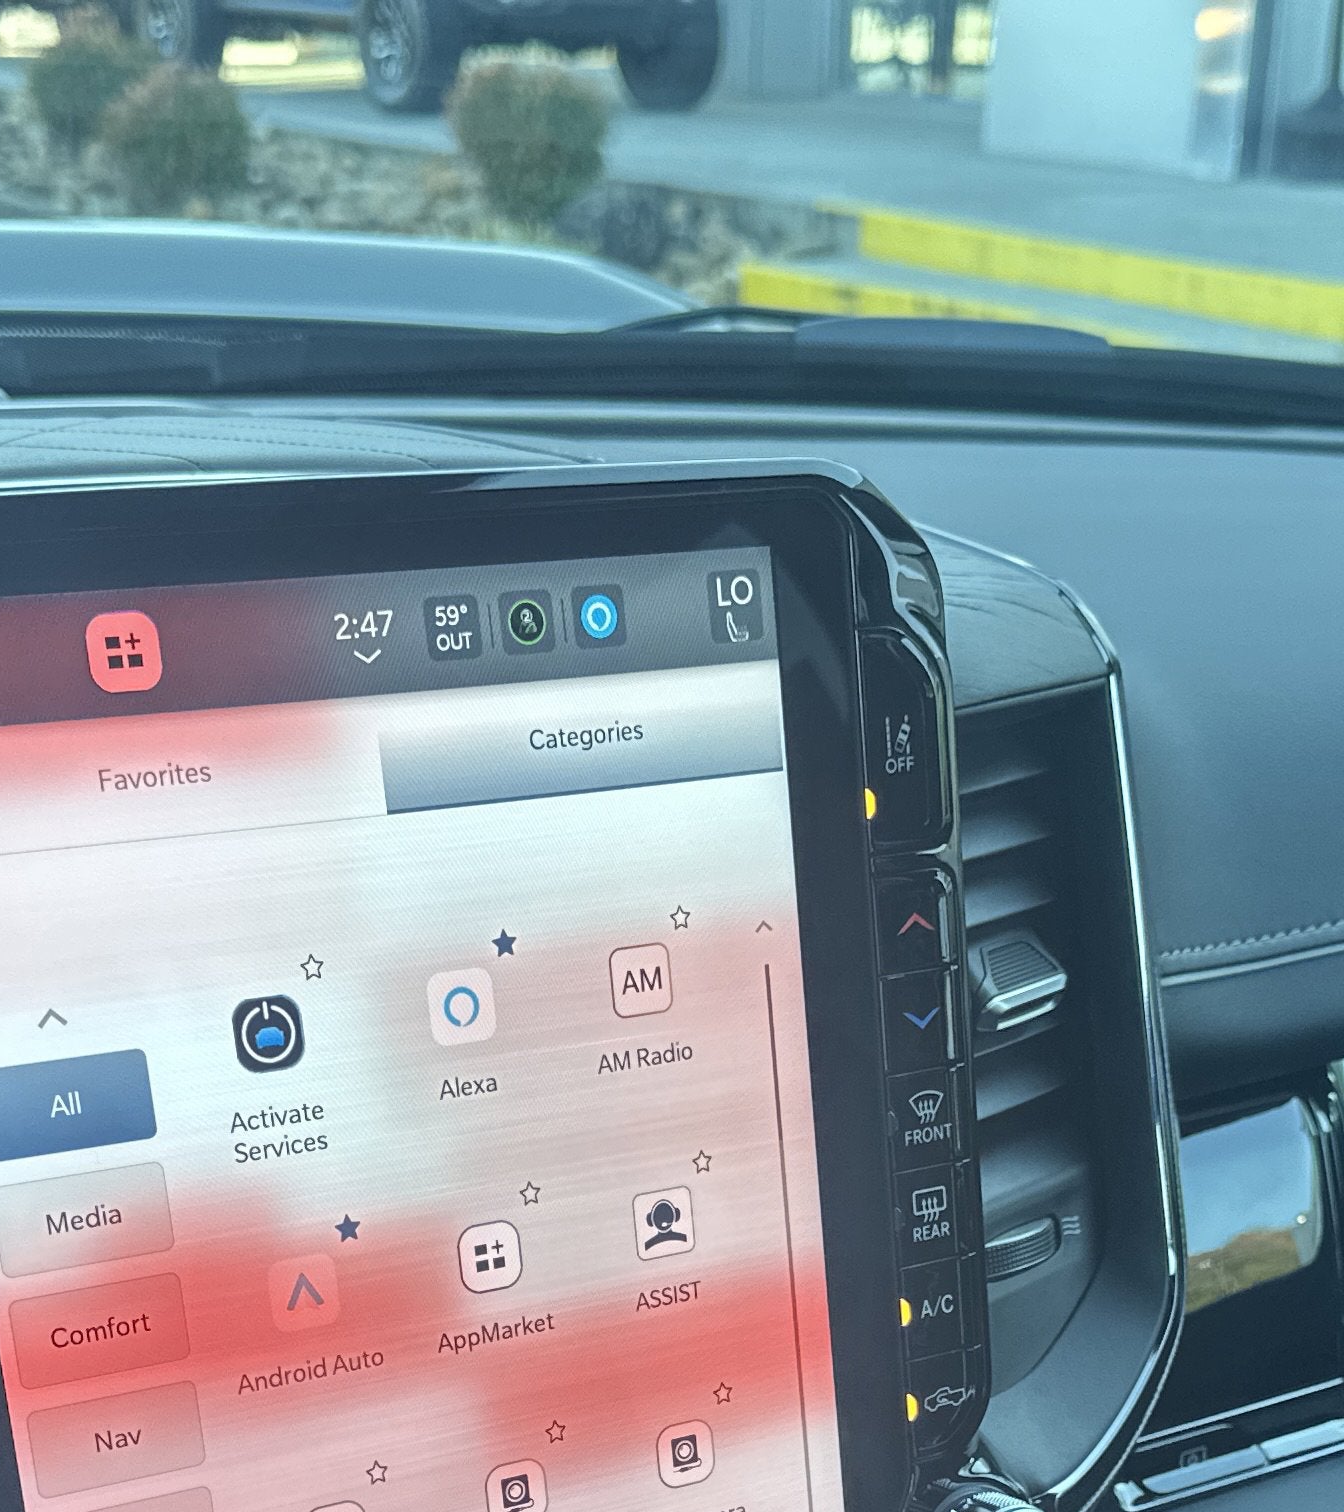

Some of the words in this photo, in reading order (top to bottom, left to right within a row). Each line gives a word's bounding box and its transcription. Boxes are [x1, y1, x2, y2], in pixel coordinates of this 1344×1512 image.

[715, 575, 754, 607] LO
[334, 610, 394, 643] 2:47
[434, 604, 468, 628] 59°
[436, 630, 473, 653] OUT
[529, 719, 644, 755] Categories
[98, 760, 212, 793] Favorites
[885, 757, 915, 775] OFF
[622, 966, 663, 995] AM
[598, 1052, 631, 1074] AM
[637, 1041, 693, 1067] Radio
[439, 1076, 498, 1100] Alexa
[50, 1091, 82, 1118] All
[230, 1102, 325, 1133] Activate
[233, 1133, 329, 1164] Services
[904, 1122, 953, 1145] FRONT
[46, 1204, 123, 1235] Media
[913, 1222, 950, 1243] REAR
[635, 1281, 702, 1312] ASSIST
[920, 1294, 954, 1319] A/C
[51, 1313, 152, 1348] Comfort
[438, 1314, 555, 1355] AppMarket
[238, 1361, 328, 1395] Android
[332, 1351, 385, 1375] Auto
[94, 1430, 142, 1453] Nav
